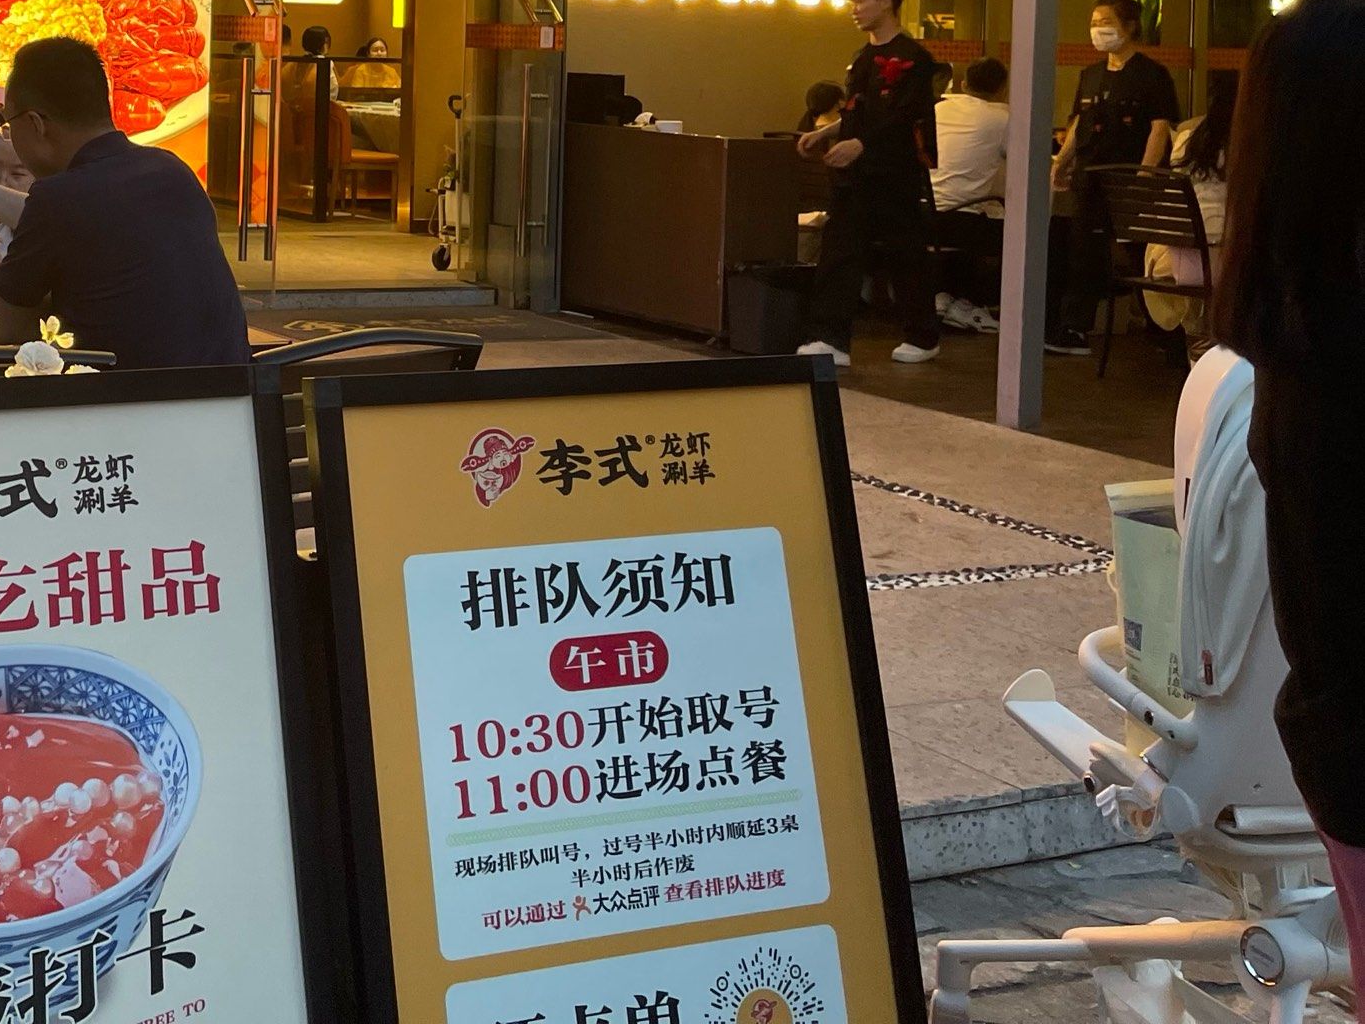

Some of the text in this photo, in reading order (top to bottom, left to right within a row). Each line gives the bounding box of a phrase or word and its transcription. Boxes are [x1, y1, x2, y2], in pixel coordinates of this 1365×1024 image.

[659, 432, 711, 458] 龙虾
[72, 454, 135, 485] 龙虾
[535, 434, 649, 496] 李式
[660, 458, 716, 485] 涮羊
[73, 484, 139, 515] 涮羊
[459, 550, 736, 632] 排队须知
[563, 639, 656, 685] 午市
[571, 854, 696, 889] 半小时后作废
[481, 868, 787, 931] 可以通过 大众点评 查看排队进度
[182, 998, 206, 1017] TO
